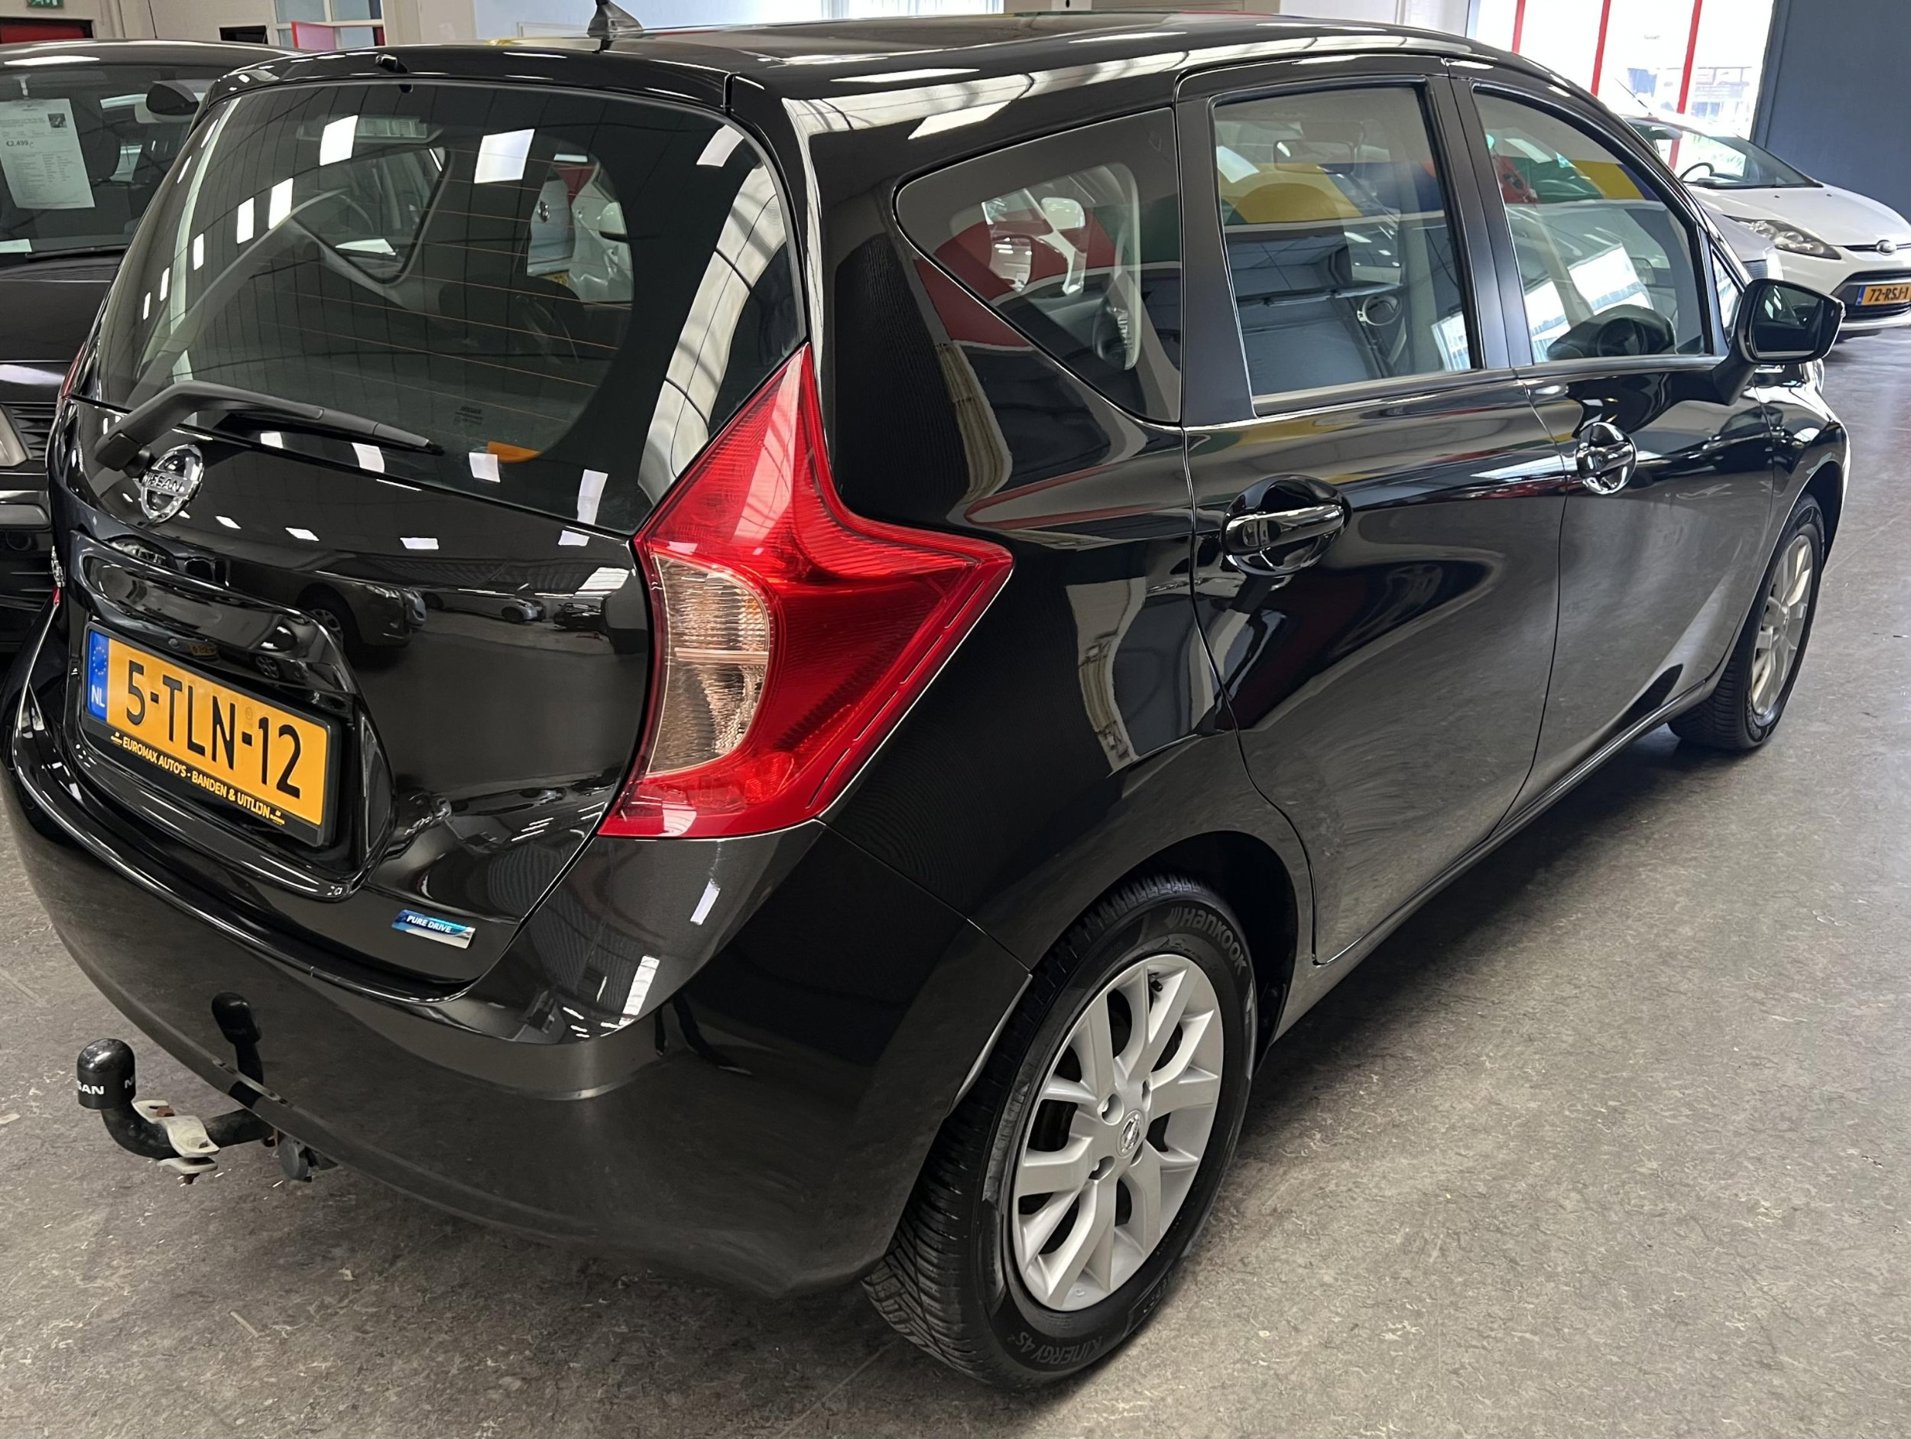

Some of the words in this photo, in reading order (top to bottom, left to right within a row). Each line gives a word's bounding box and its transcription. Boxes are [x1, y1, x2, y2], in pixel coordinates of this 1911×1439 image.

[91, 684, 106, 708] NL
[126, 659, 302, 800] 5-TLN-12
[123, 736, 159, 764] EUROMAX
[158, 755, 187, 778] AUTO'S
[191, 771, 227, 798] BANDEN
[228, 788, 236, 800] &
[406, 915, 427, 927] PURE
[428, 921, 453, 934] DRIVE
